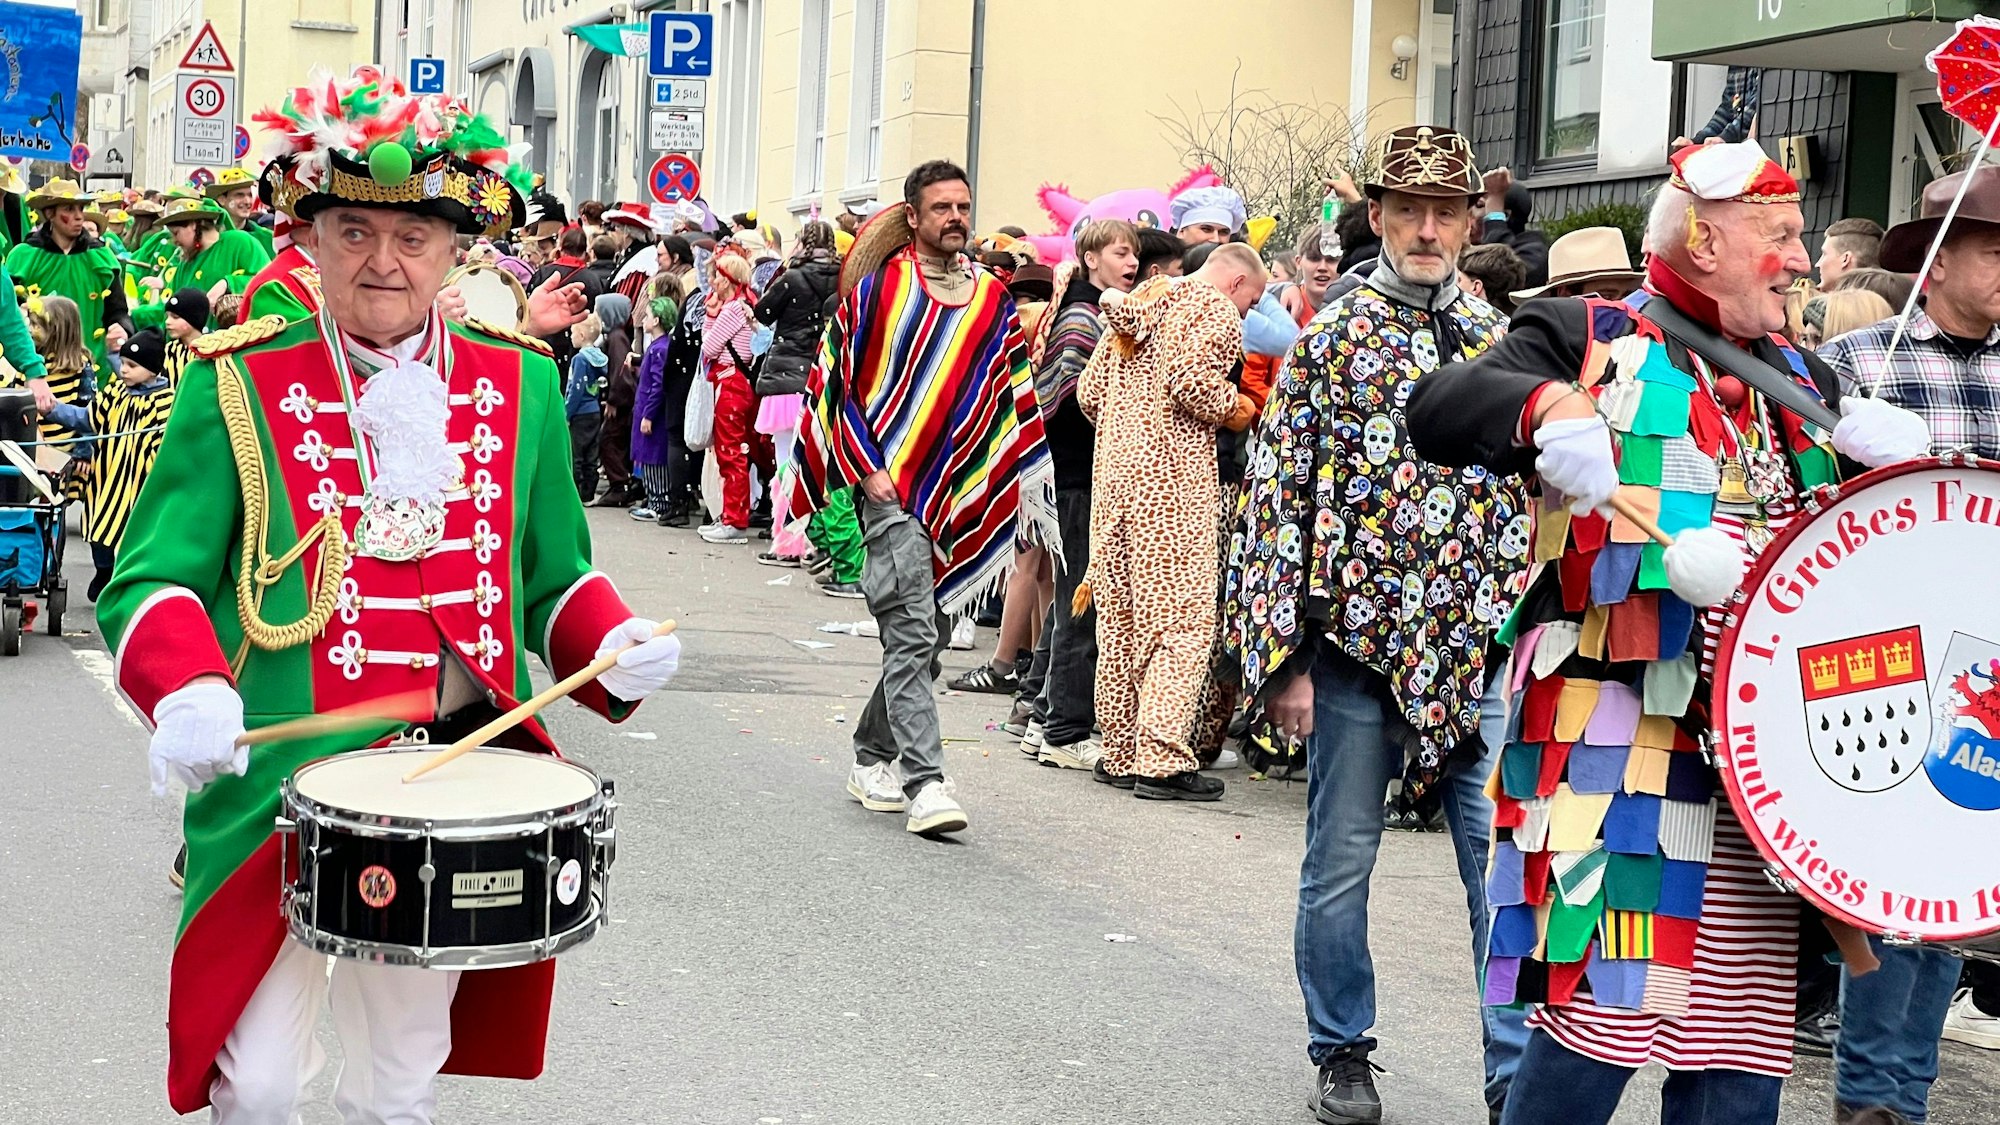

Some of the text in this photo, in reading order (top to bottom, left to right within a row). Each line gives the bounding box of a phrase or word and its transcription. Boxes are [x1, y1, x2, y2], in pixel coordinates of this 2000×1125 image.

[664, 20, 701, 68] P
[418, 63, 437, 89] P
[194, 89, 216, 107] 30
[674, 89, 680, 98] 2
[187, 121, 221, 131] Werktags
[660, 123, 694, 132] Werktags
[1744, 479, 2000, 666] 1. Großes Fu
[1732, 722, 1783, 817] ruut
[1773, 817, 1868, 906] wiess
[1880, 891, 1959, 923] vun
